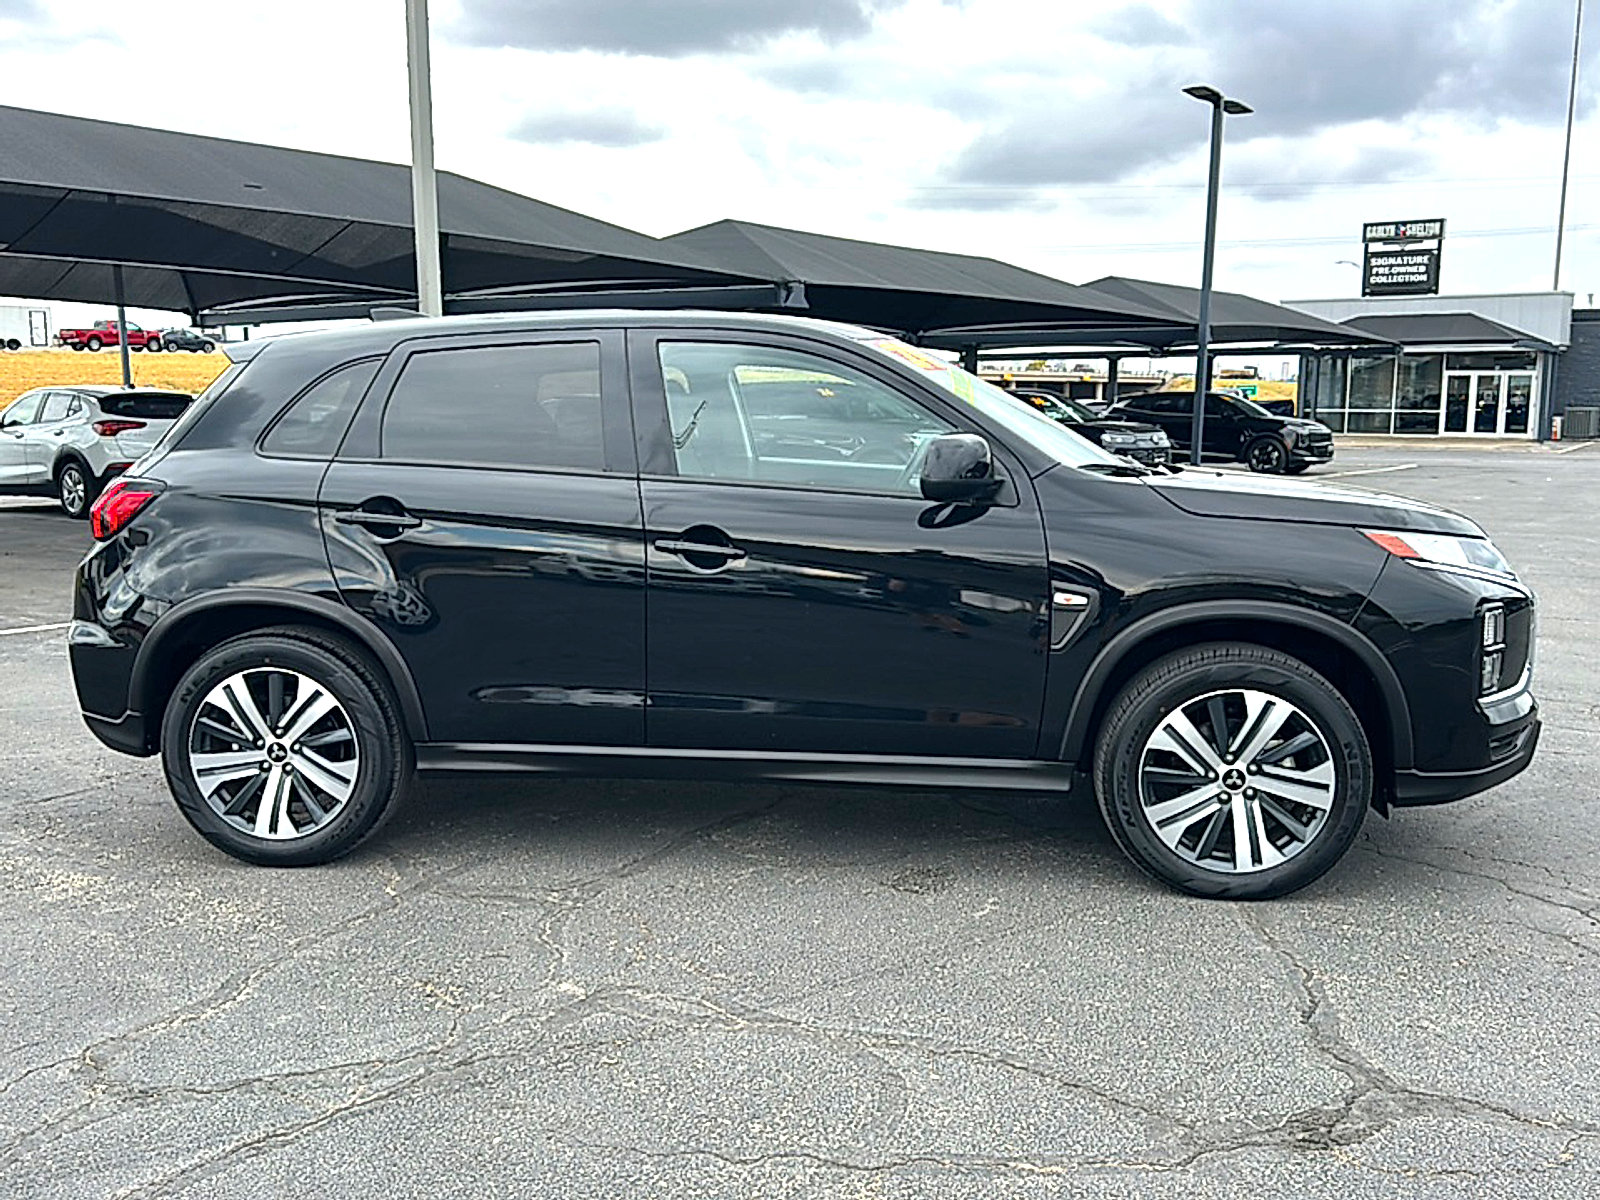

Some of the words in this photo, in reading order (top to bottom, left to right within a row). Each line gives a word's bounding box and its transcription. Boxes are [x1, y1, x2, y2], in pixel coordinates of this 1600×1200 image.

[1370, 255, 1430, 266] SIGNATURE
[1372, 265, 1426, 274] PRE-OWNED
[1370, 274, 1428, 284] COLLECTION
